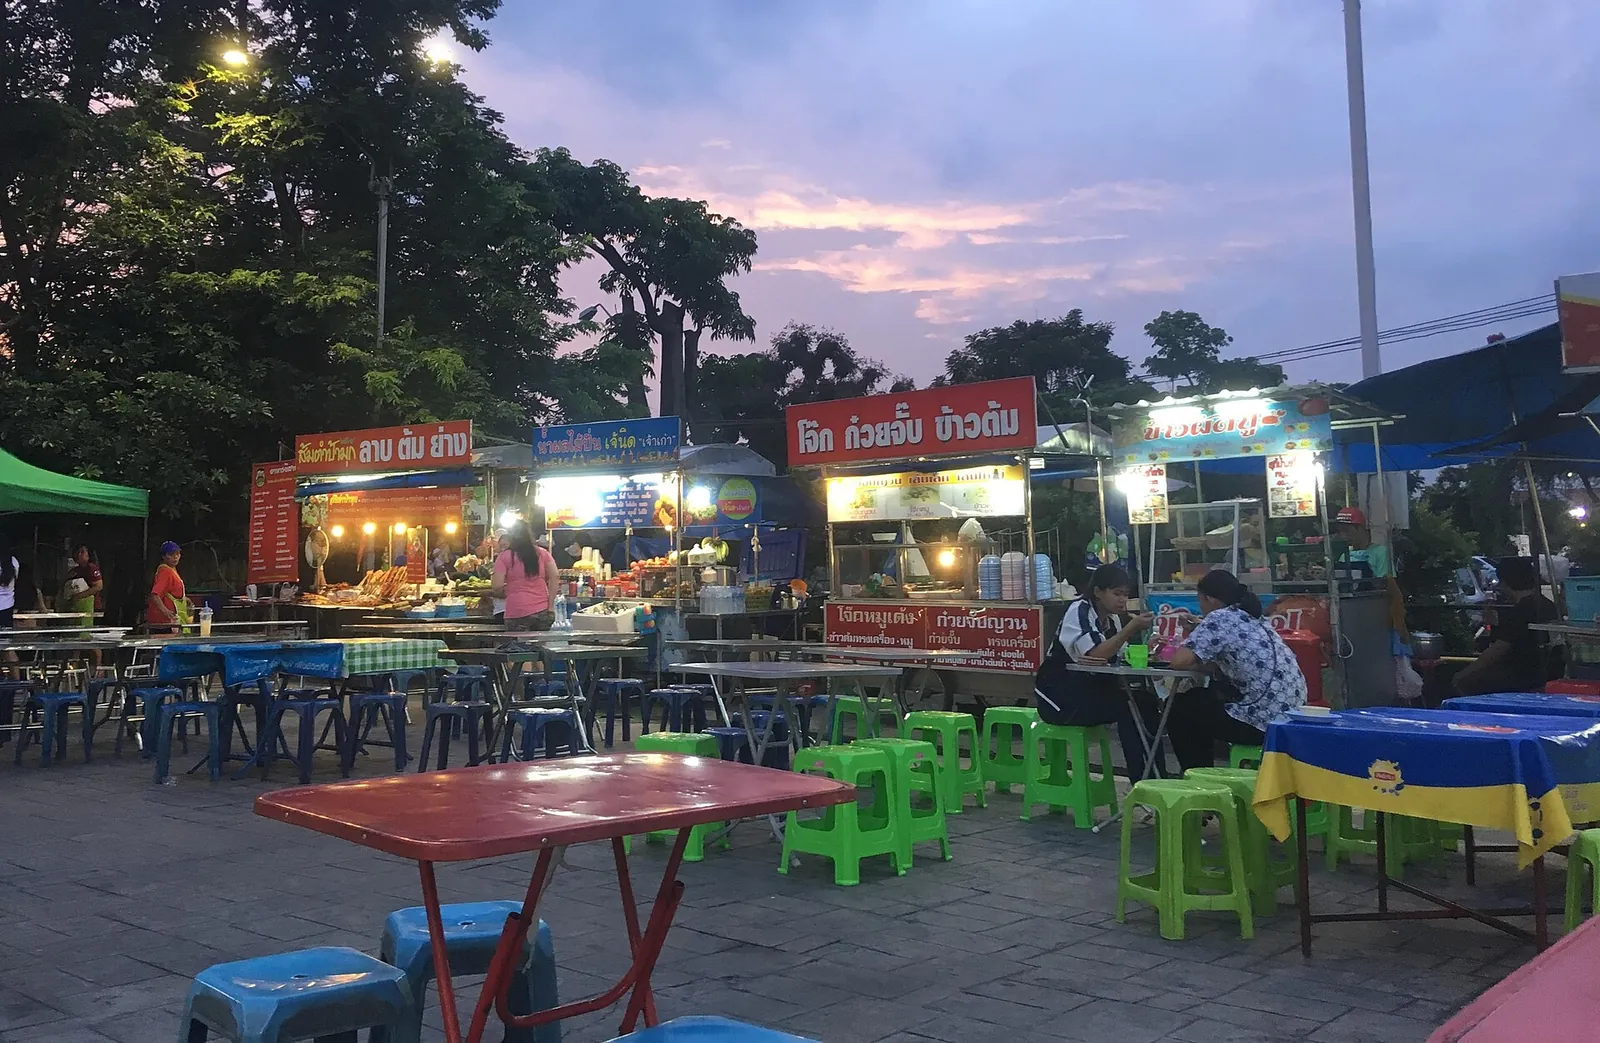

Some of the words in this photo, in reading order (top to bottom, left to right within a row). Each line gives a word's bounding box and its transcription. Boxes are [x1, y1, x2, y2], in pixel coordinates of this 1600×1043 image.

[537, 426, 602, 455] น้ำผลไม้ปั่น
[797, 418, 834, 454] โจ๊ก
[845, 402, 924, 450] ก๋วยจั๊บ
[934, 400, 1020, 442] ข้าวต้ม
[359, 438, 393, 464] ลาบ
[397, 428, 425, 460] ต้ม
[430, 426, 467, 458] ย่าง
[987, 631, 1037, 648] ทรงเครื่อง
